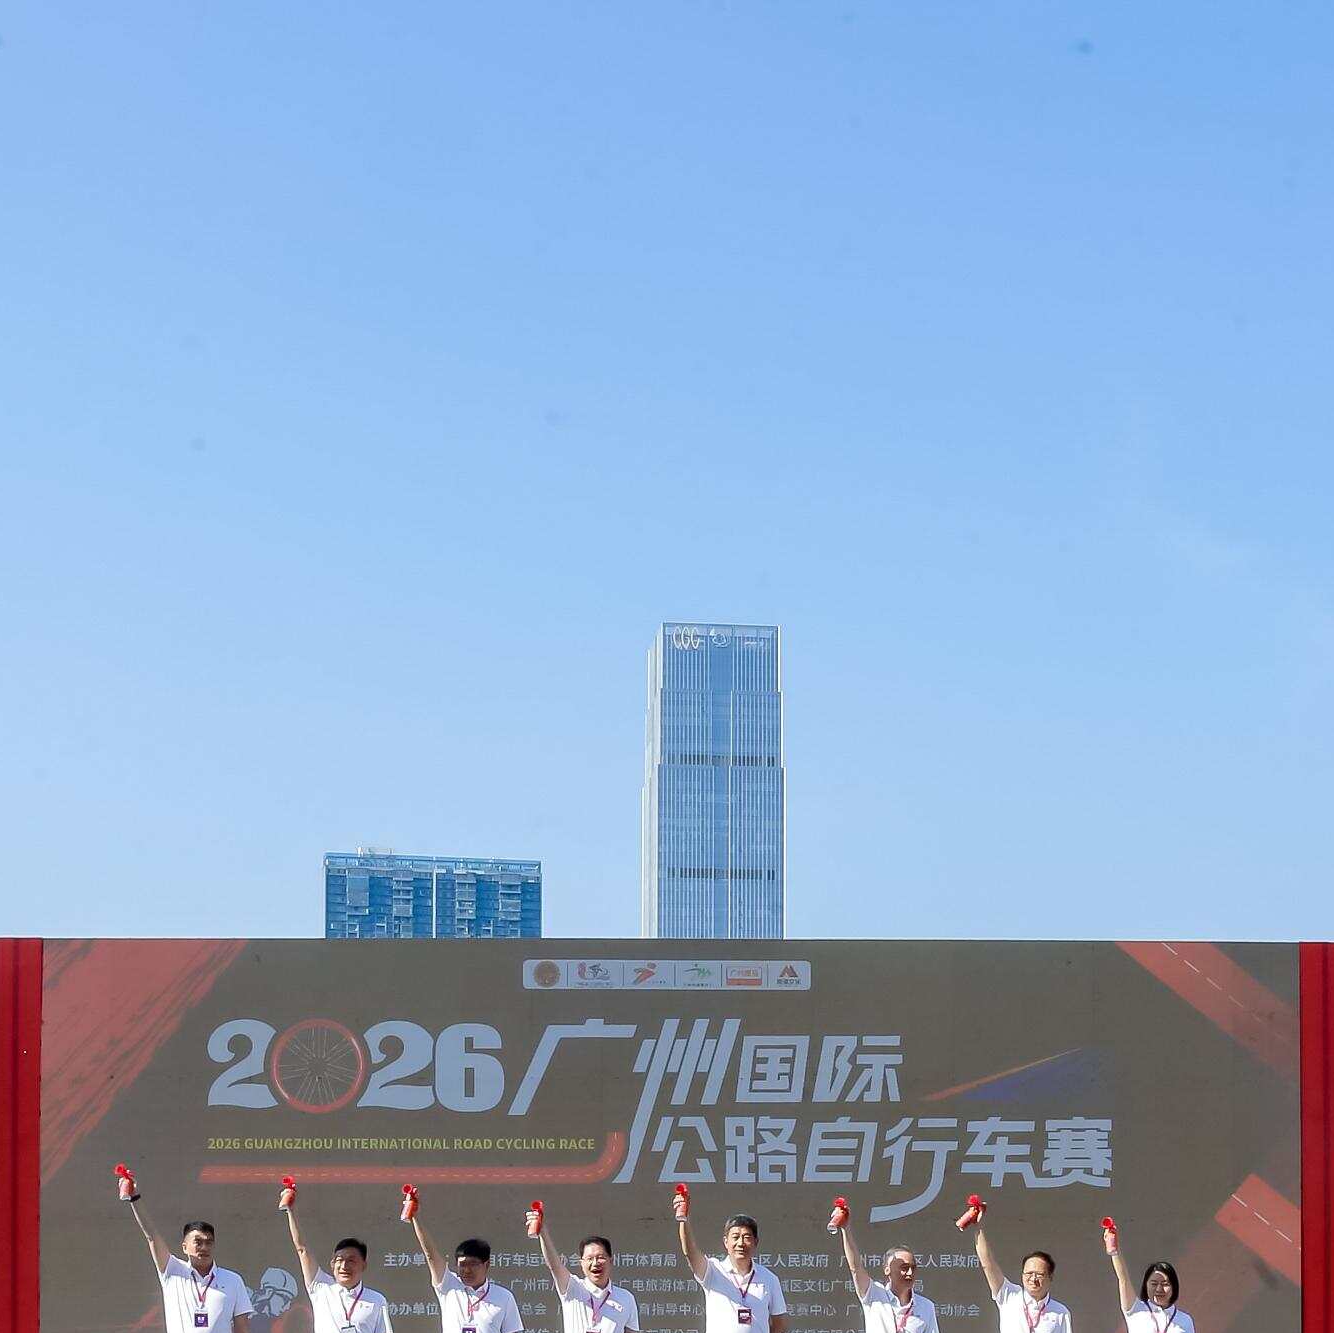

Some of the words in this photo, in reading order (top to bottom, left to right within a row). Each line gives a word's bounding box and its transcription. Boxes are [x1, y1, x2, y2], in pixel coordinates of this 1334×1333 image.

[207, 1138, 240, 1150] 2026
[244, 1138, 333, 1150] GUANGZHOU
[336, 1138, 449, 1150] INTERNATIONAL
[453, 1138, 492, 1150] ROAD
[496, 1138, 555, 1150] CYCLING
[559, 1138, 595, 1150] RACE
[651, 1114, 1113, 1221] 公路自行车赛
[383, 1252, 450, 1267] 主办单：
